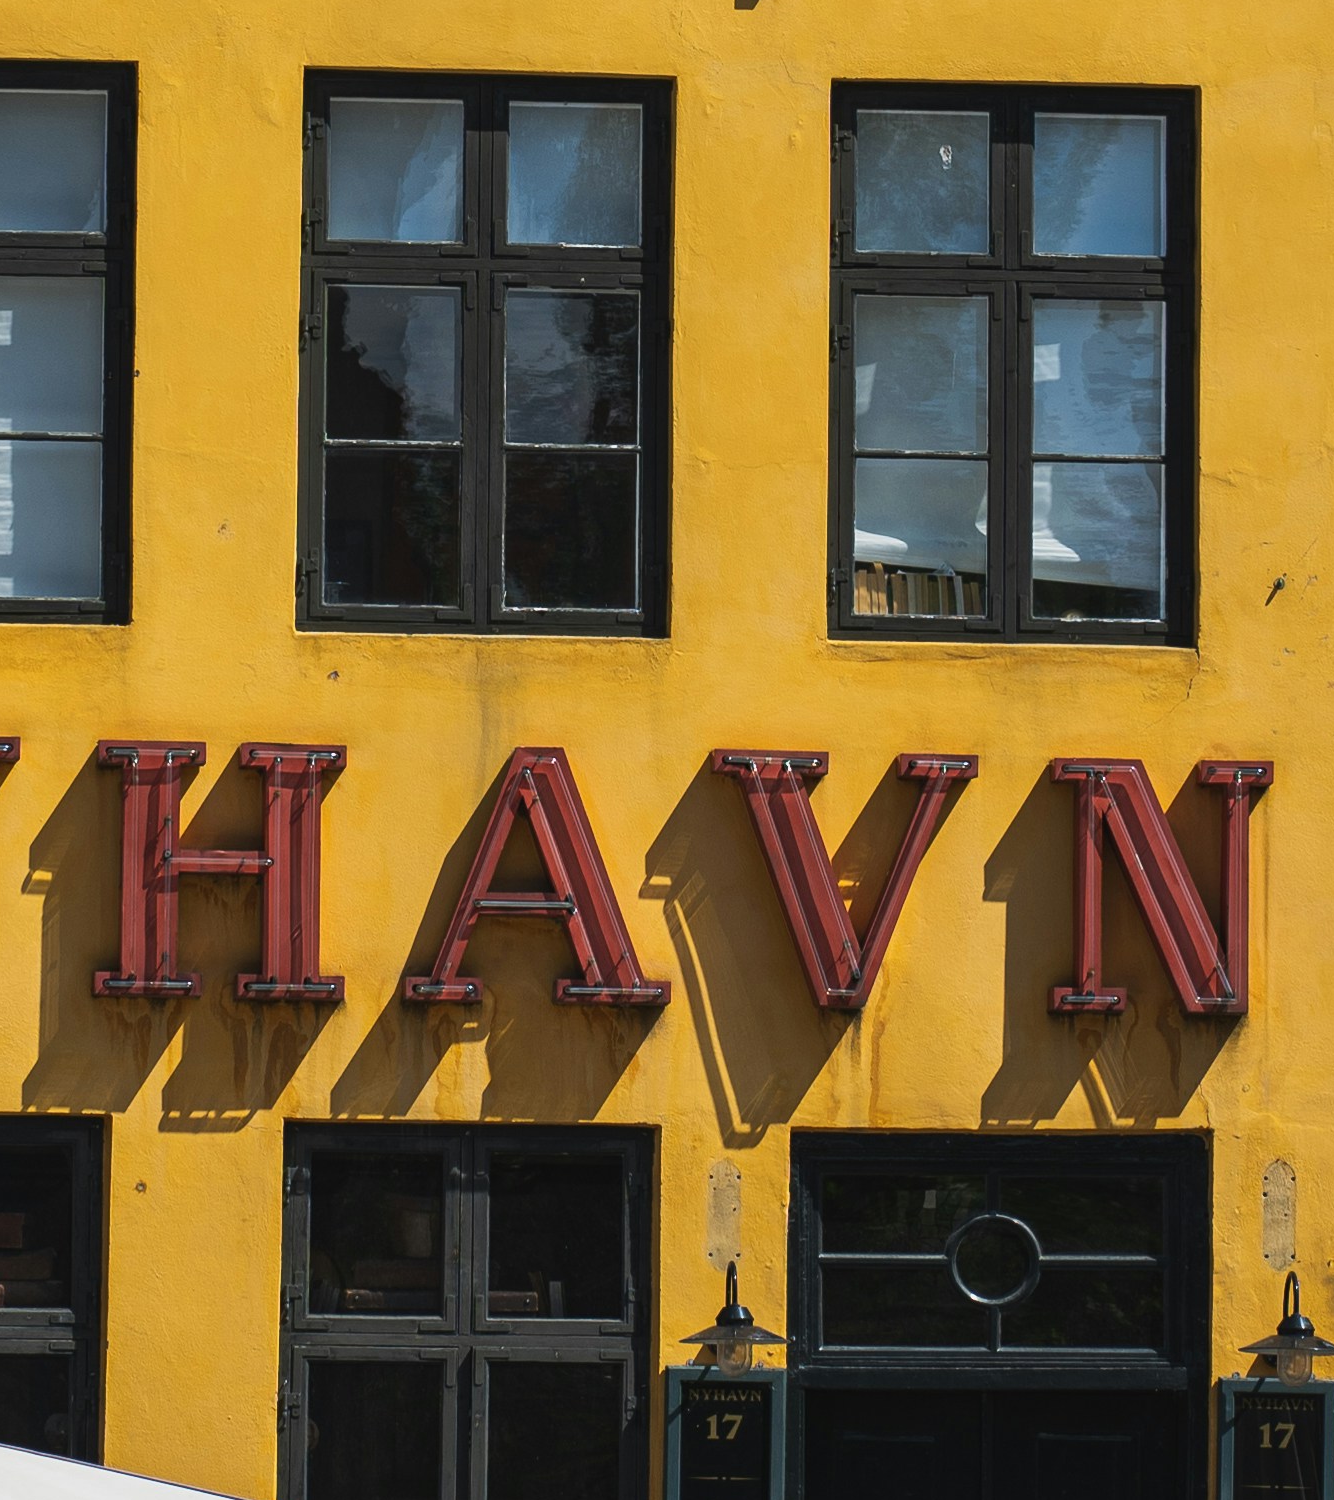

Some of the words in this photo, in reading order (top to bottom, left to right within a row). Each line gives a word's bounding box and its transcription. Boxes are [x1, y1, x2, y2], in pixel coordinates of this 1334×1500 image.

[688, 1388, 762, 1402] NYHAVN
[1241, 1398, 1315, 1412] NYHAVN
[705, 1413, 744, 1440] 17
[1258, 1422, 1296, 1449] 17
